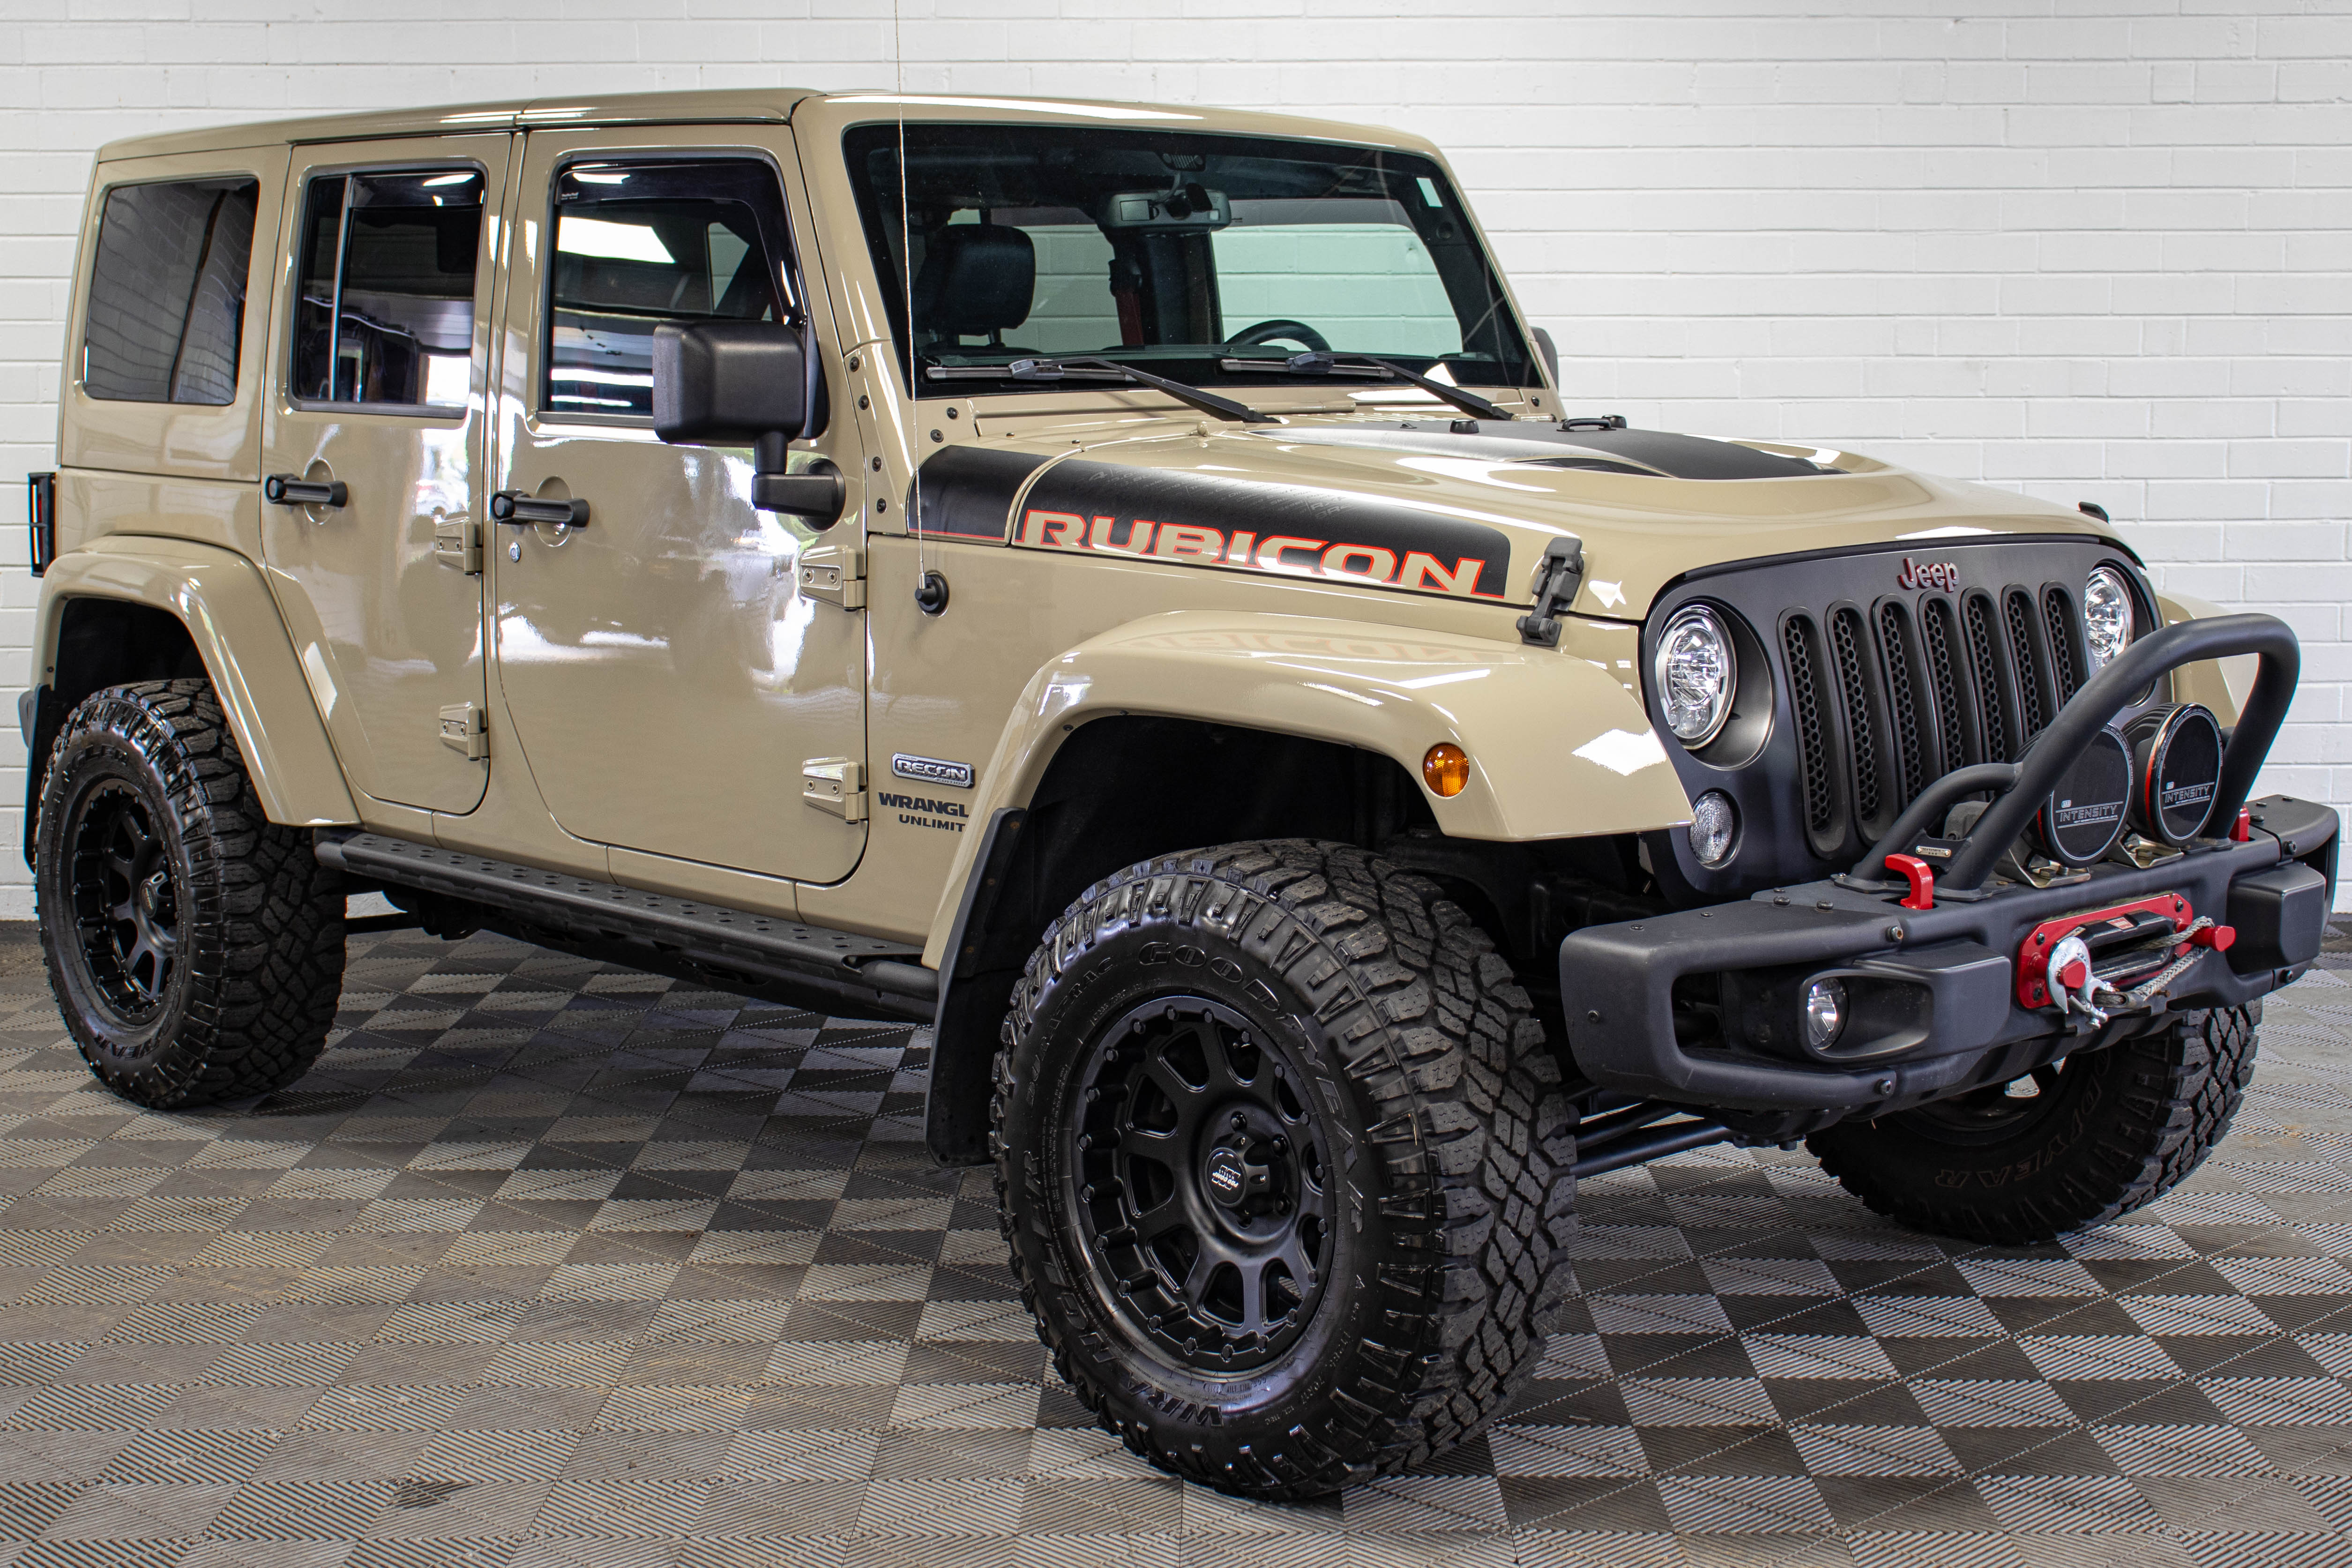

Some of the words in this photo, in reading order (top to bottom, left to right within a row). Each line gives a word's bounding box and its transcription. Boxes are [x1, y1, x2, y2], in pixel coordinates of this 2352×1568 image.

[1022, 509, 1486, 598] RUBICON
[1898, 558, 1960, 592] Jeep
[897, 760, 966, 780] RECON
[2165, 785, 2210, 803] INTENSITY
[878, 792, 970, 818] WRANGL
[2060, 805, 2117, 822] INTENSITY
[898, 814, 966, 832] UNLIMIT
